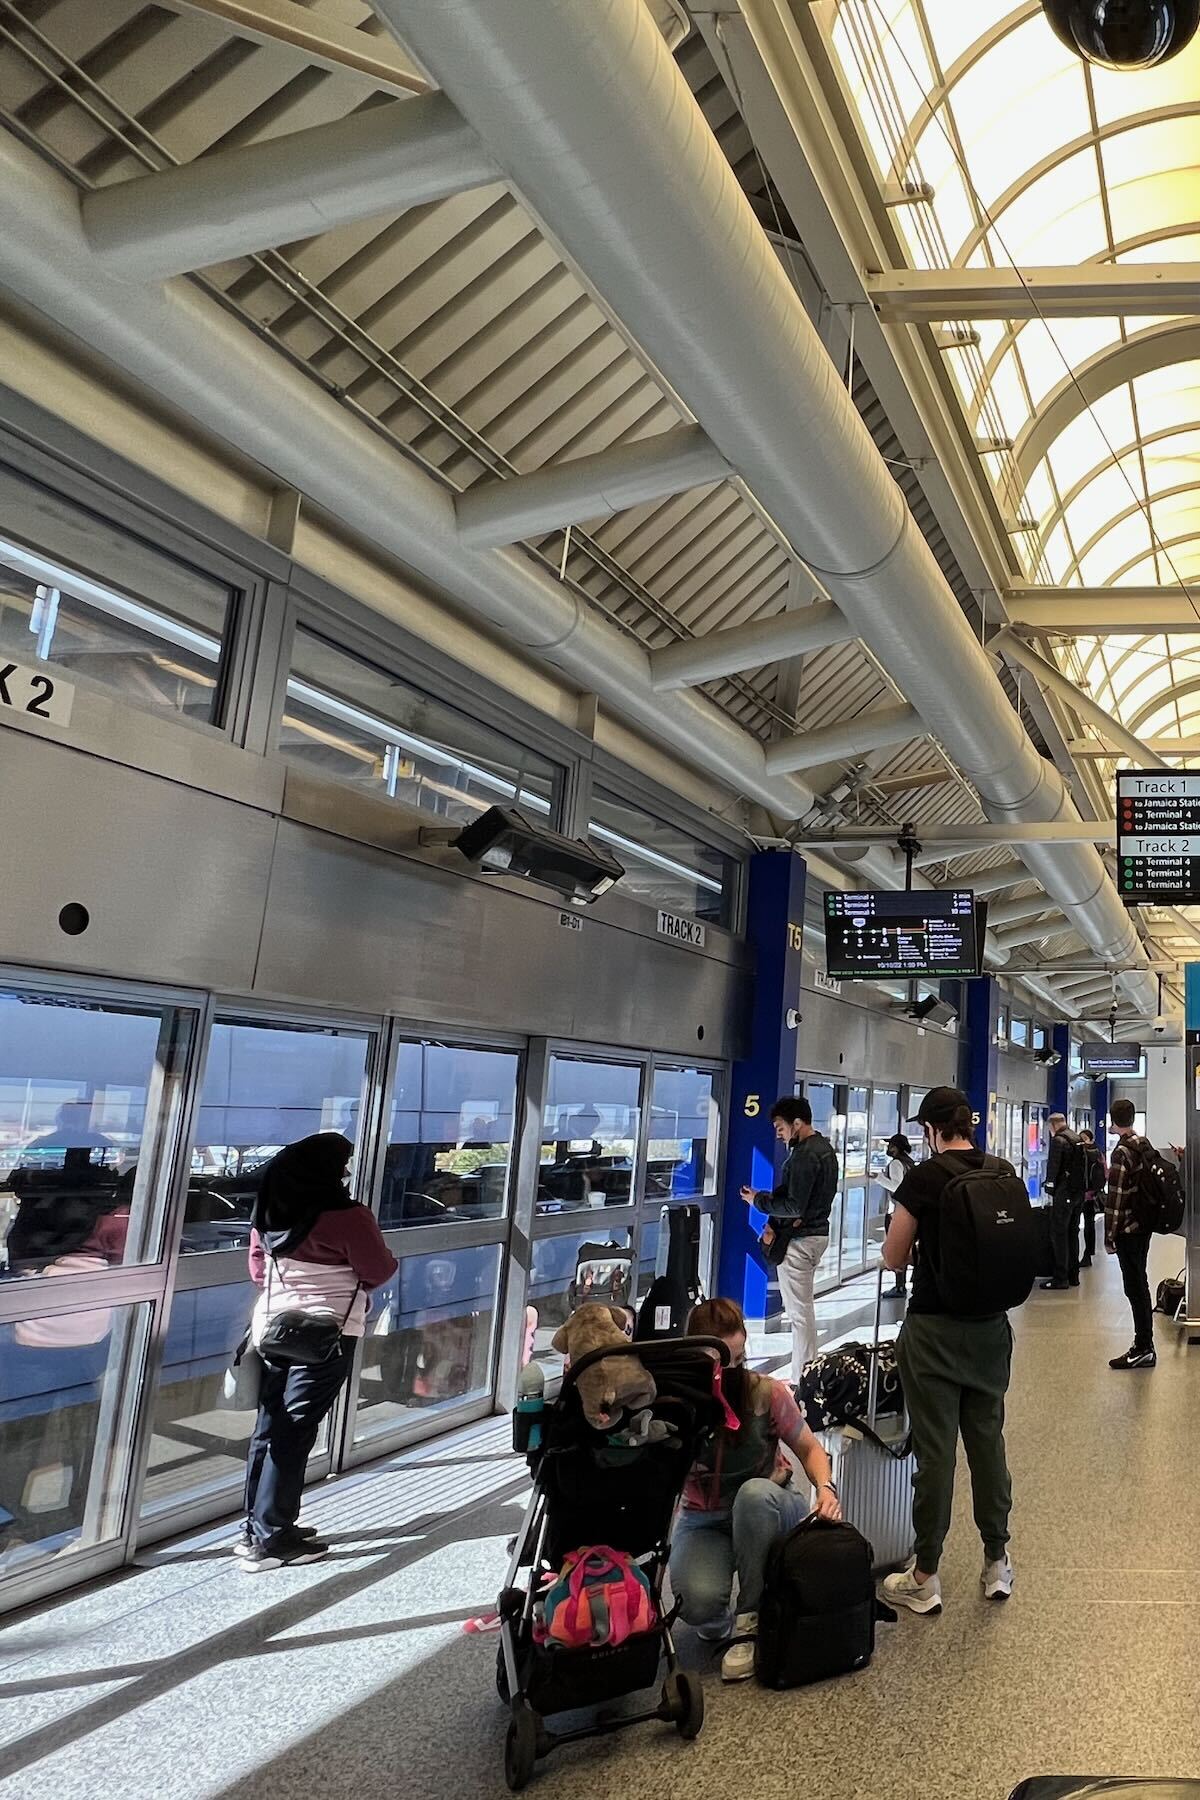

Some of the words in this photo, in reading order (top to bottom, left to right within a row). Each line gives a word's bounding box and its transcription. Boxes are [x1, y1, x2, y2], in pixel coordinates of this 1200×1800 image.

[26, 676, 54, 718] 2
[1136, 781, 1175, 793] Track
[1181, 780, 1186, 793] 1
[1144, 799, 1177, 807] Jamaica
[1144, 822, 1177, 830] Jamaica
[1136, 840, 1175, 852] Track
[1182, 840, 1189, 851] 2
[661, 912, 693, 941] TRACK
[695, 926, 701, 943] 2
[787, 922, 802, 950] T5
[744, 1095, 760, 1116] 5
[971, 1112, 980, 1124] 5
